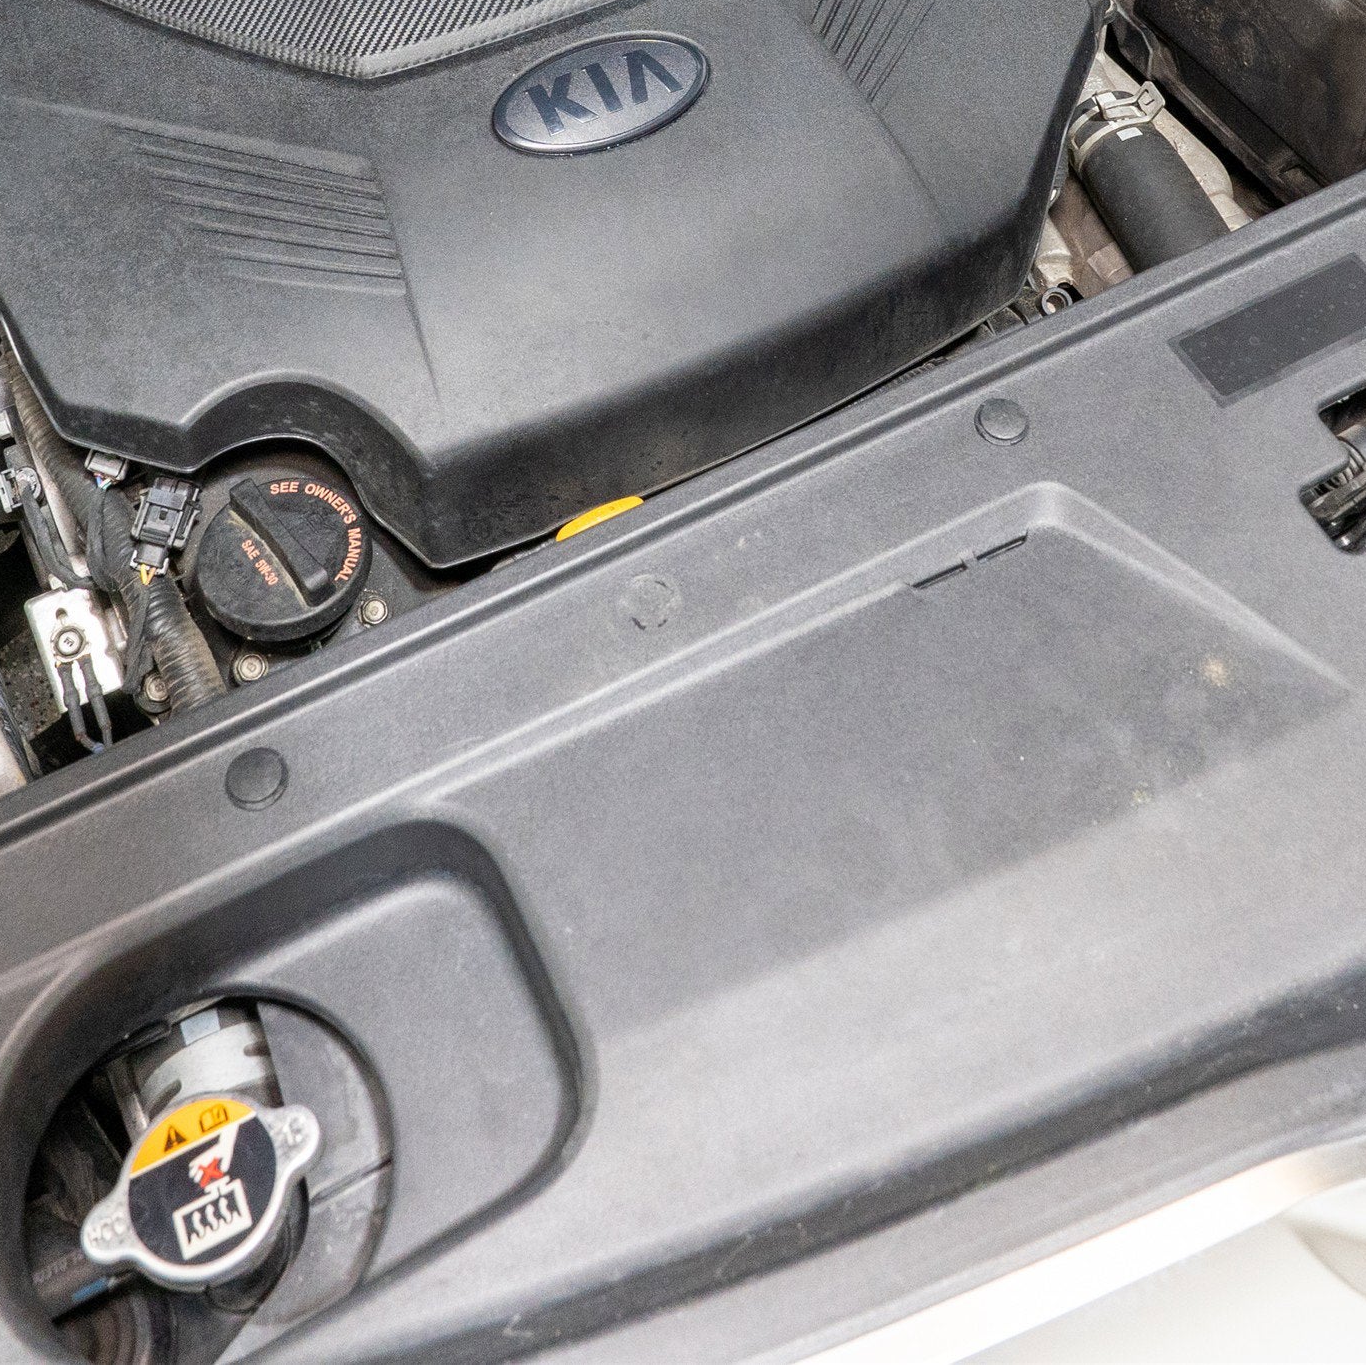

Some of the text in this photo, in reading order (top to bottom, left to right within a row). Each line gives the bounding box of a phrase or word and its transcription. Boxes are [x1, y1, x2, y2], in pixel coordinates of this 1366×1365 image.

[524, 49, 684, 137] KIA
[241, 539, 279, 586] SAE 5W-30
[269, 481, 362, 581] SEE OWNER'S MANUAL
